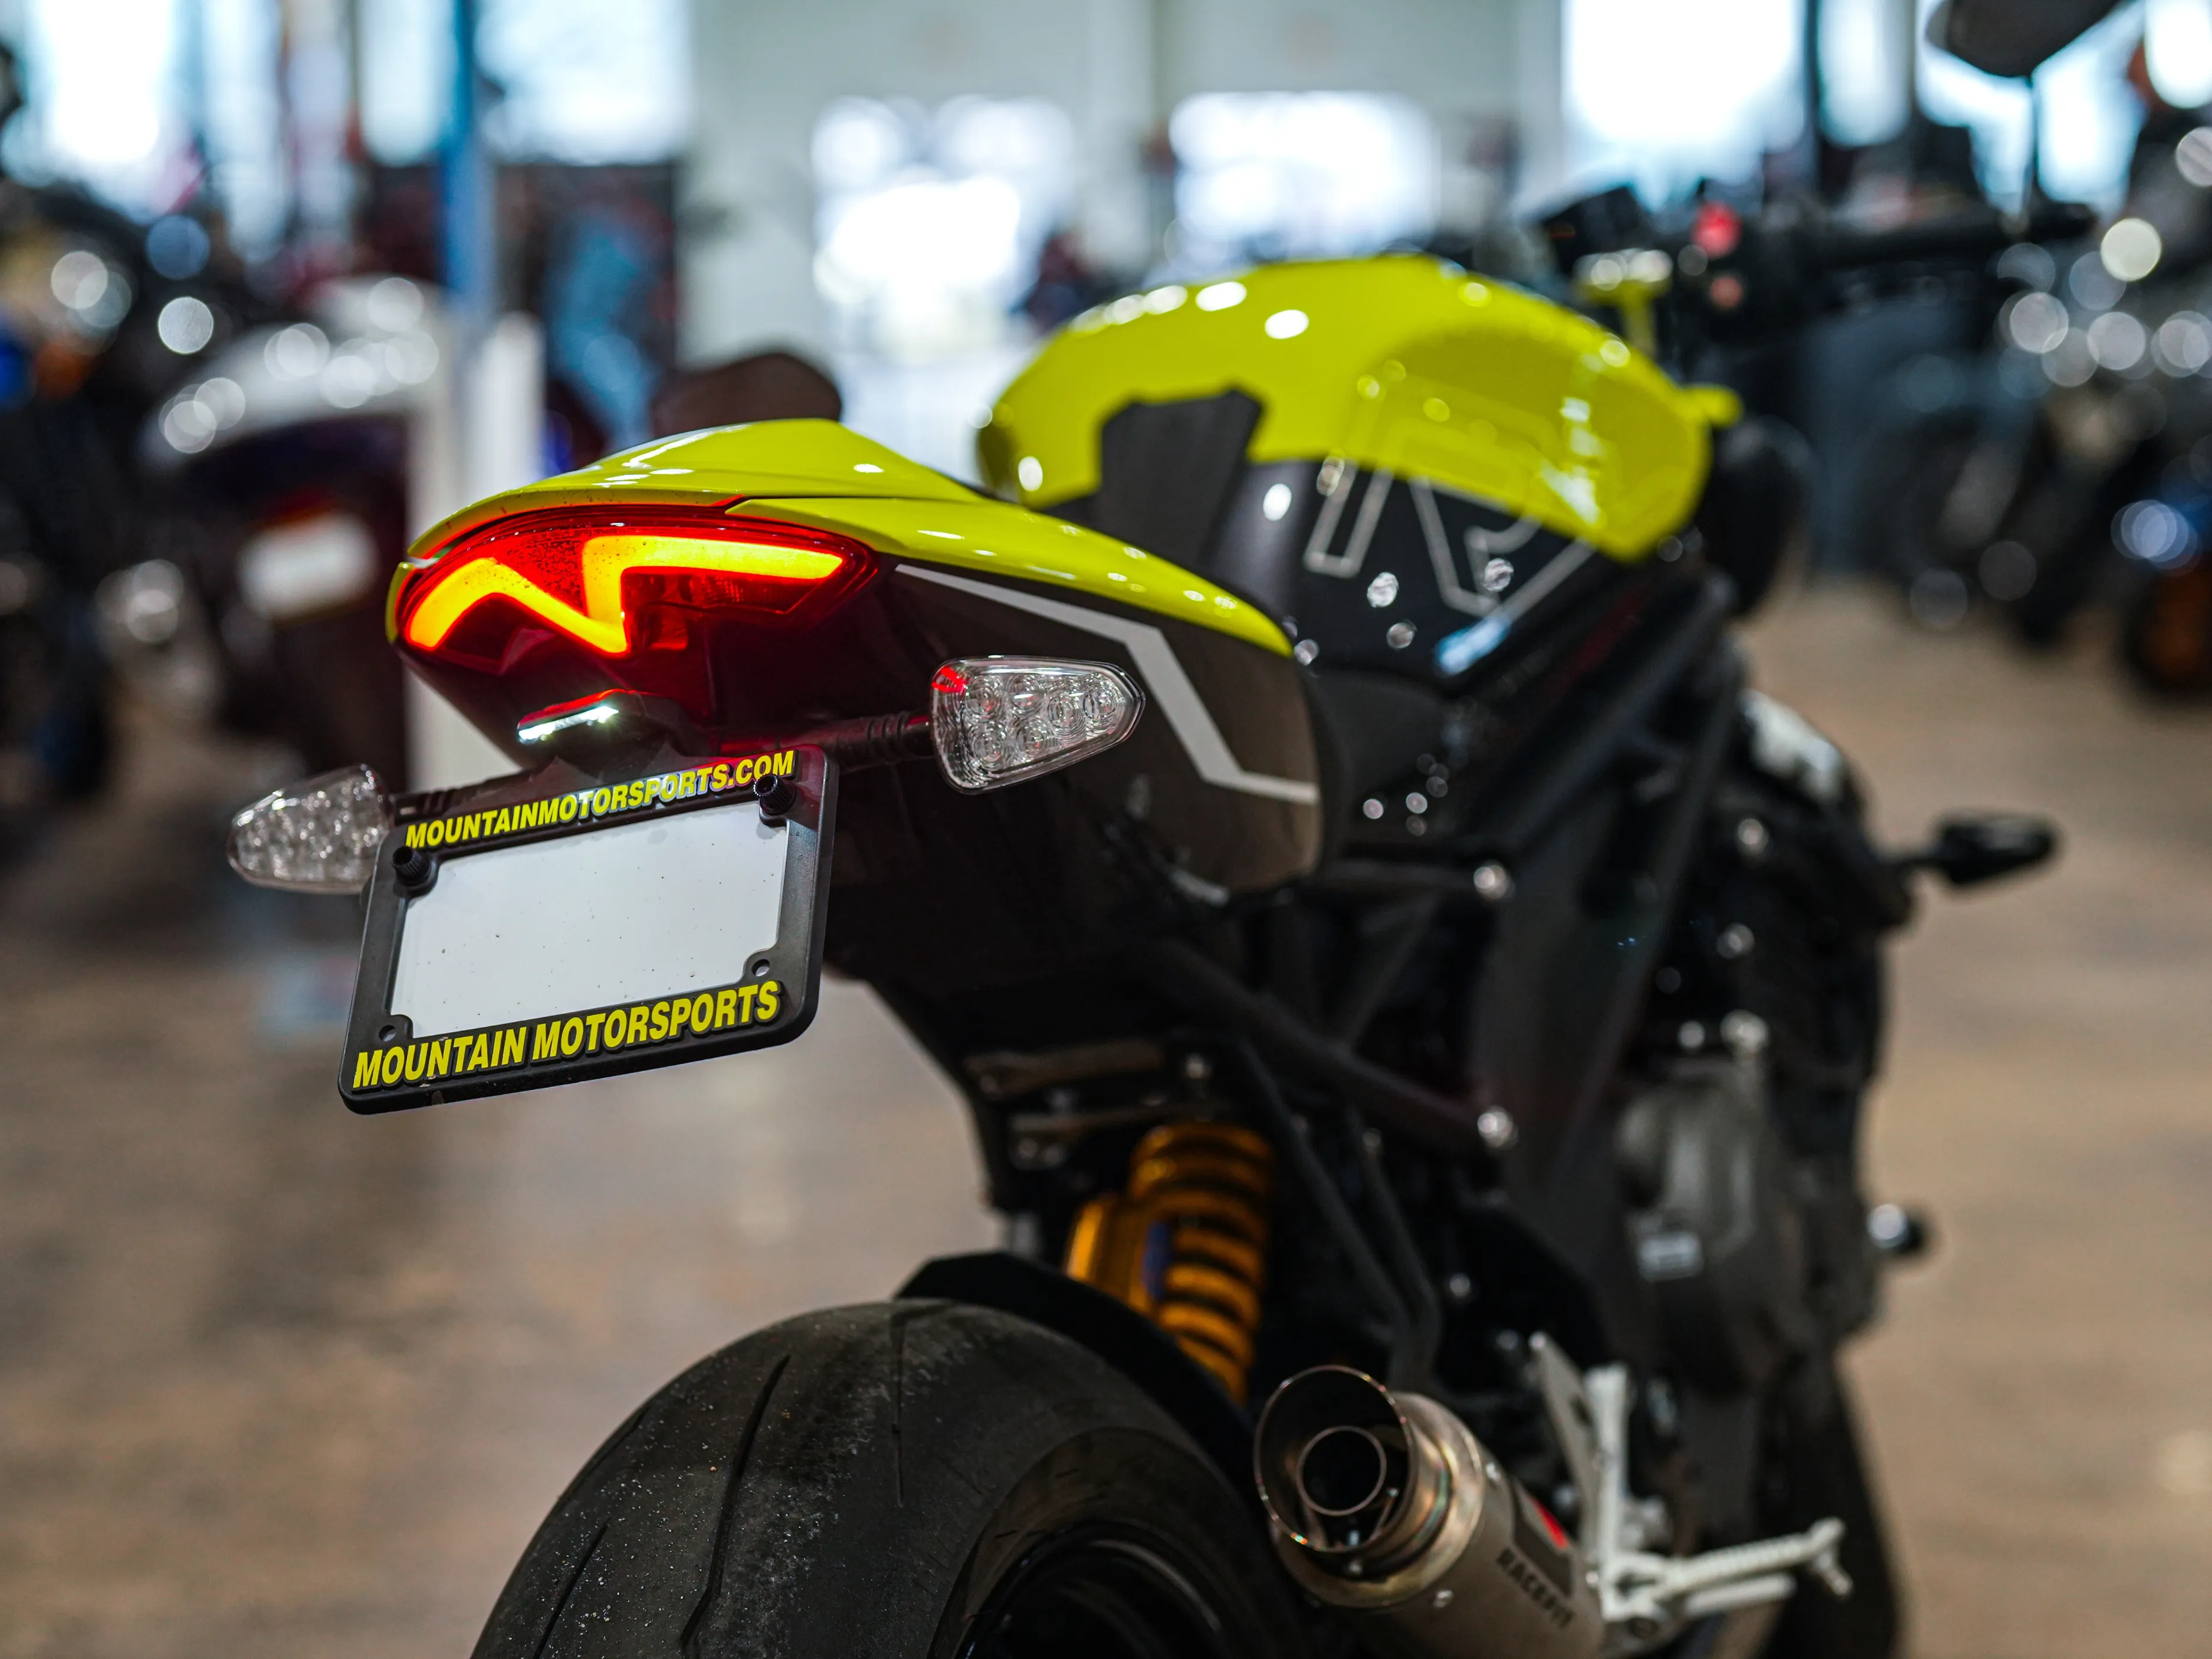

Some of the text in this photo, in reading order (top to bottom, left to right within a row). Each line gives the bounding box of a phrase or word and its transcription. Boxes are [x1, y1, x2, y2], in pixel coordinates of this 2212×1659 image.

[405, 749, 795, 850] MOUNTAINMOTORSPORTS.COM
[353, 980, 779, 1089] MOUNTAIN MOTORSPORTS
